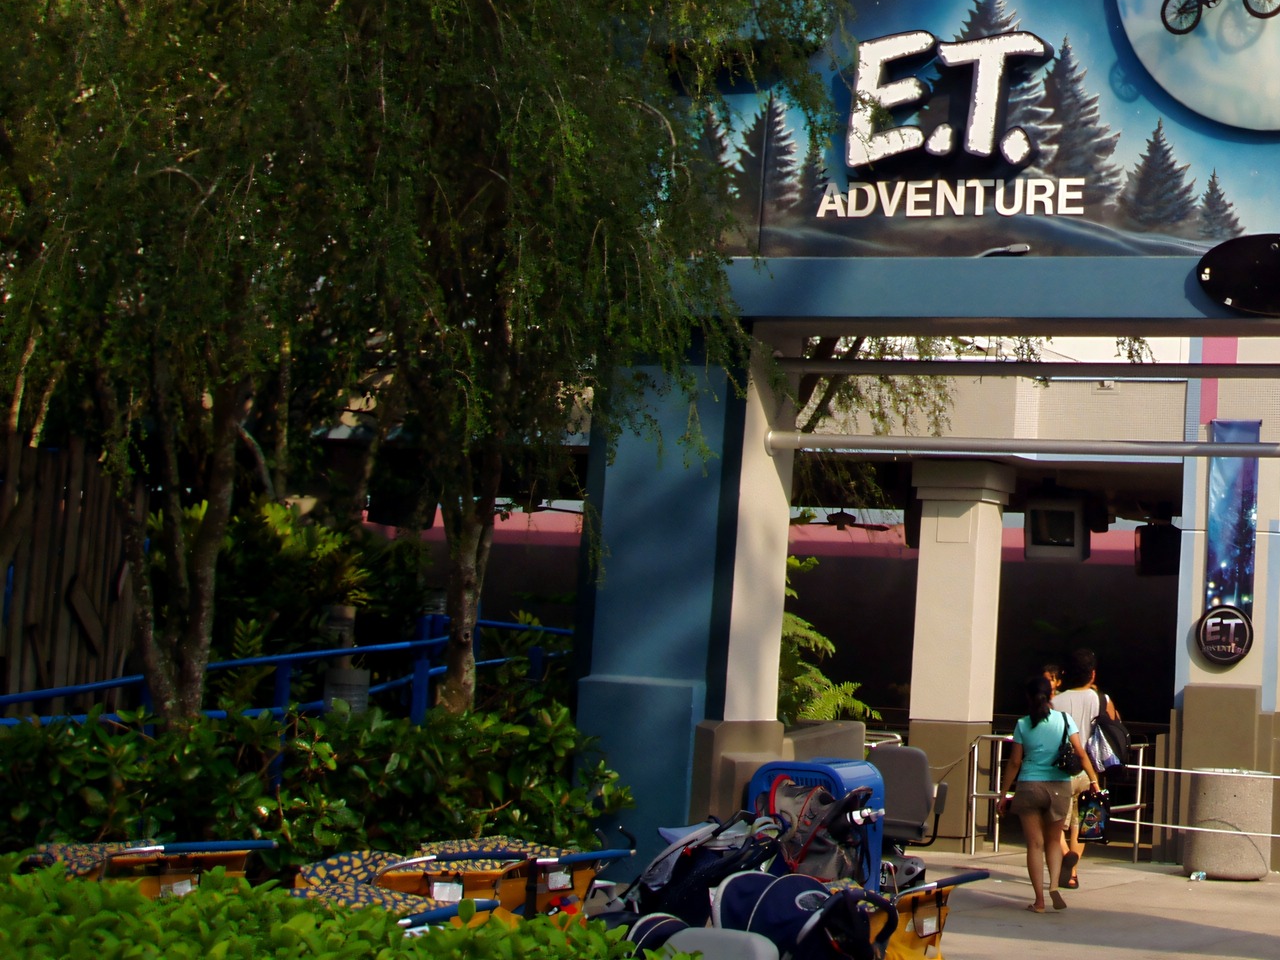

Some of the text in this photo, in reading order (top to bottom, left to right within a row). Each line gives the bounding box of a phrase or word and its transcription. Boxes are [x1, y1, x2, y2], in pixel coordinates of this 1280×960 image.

[846, 29, 1045, 168] E.T.
[816, 178, 1086, 218] ADVENTURE
[1206, 617, 1244, 643] E.T.
